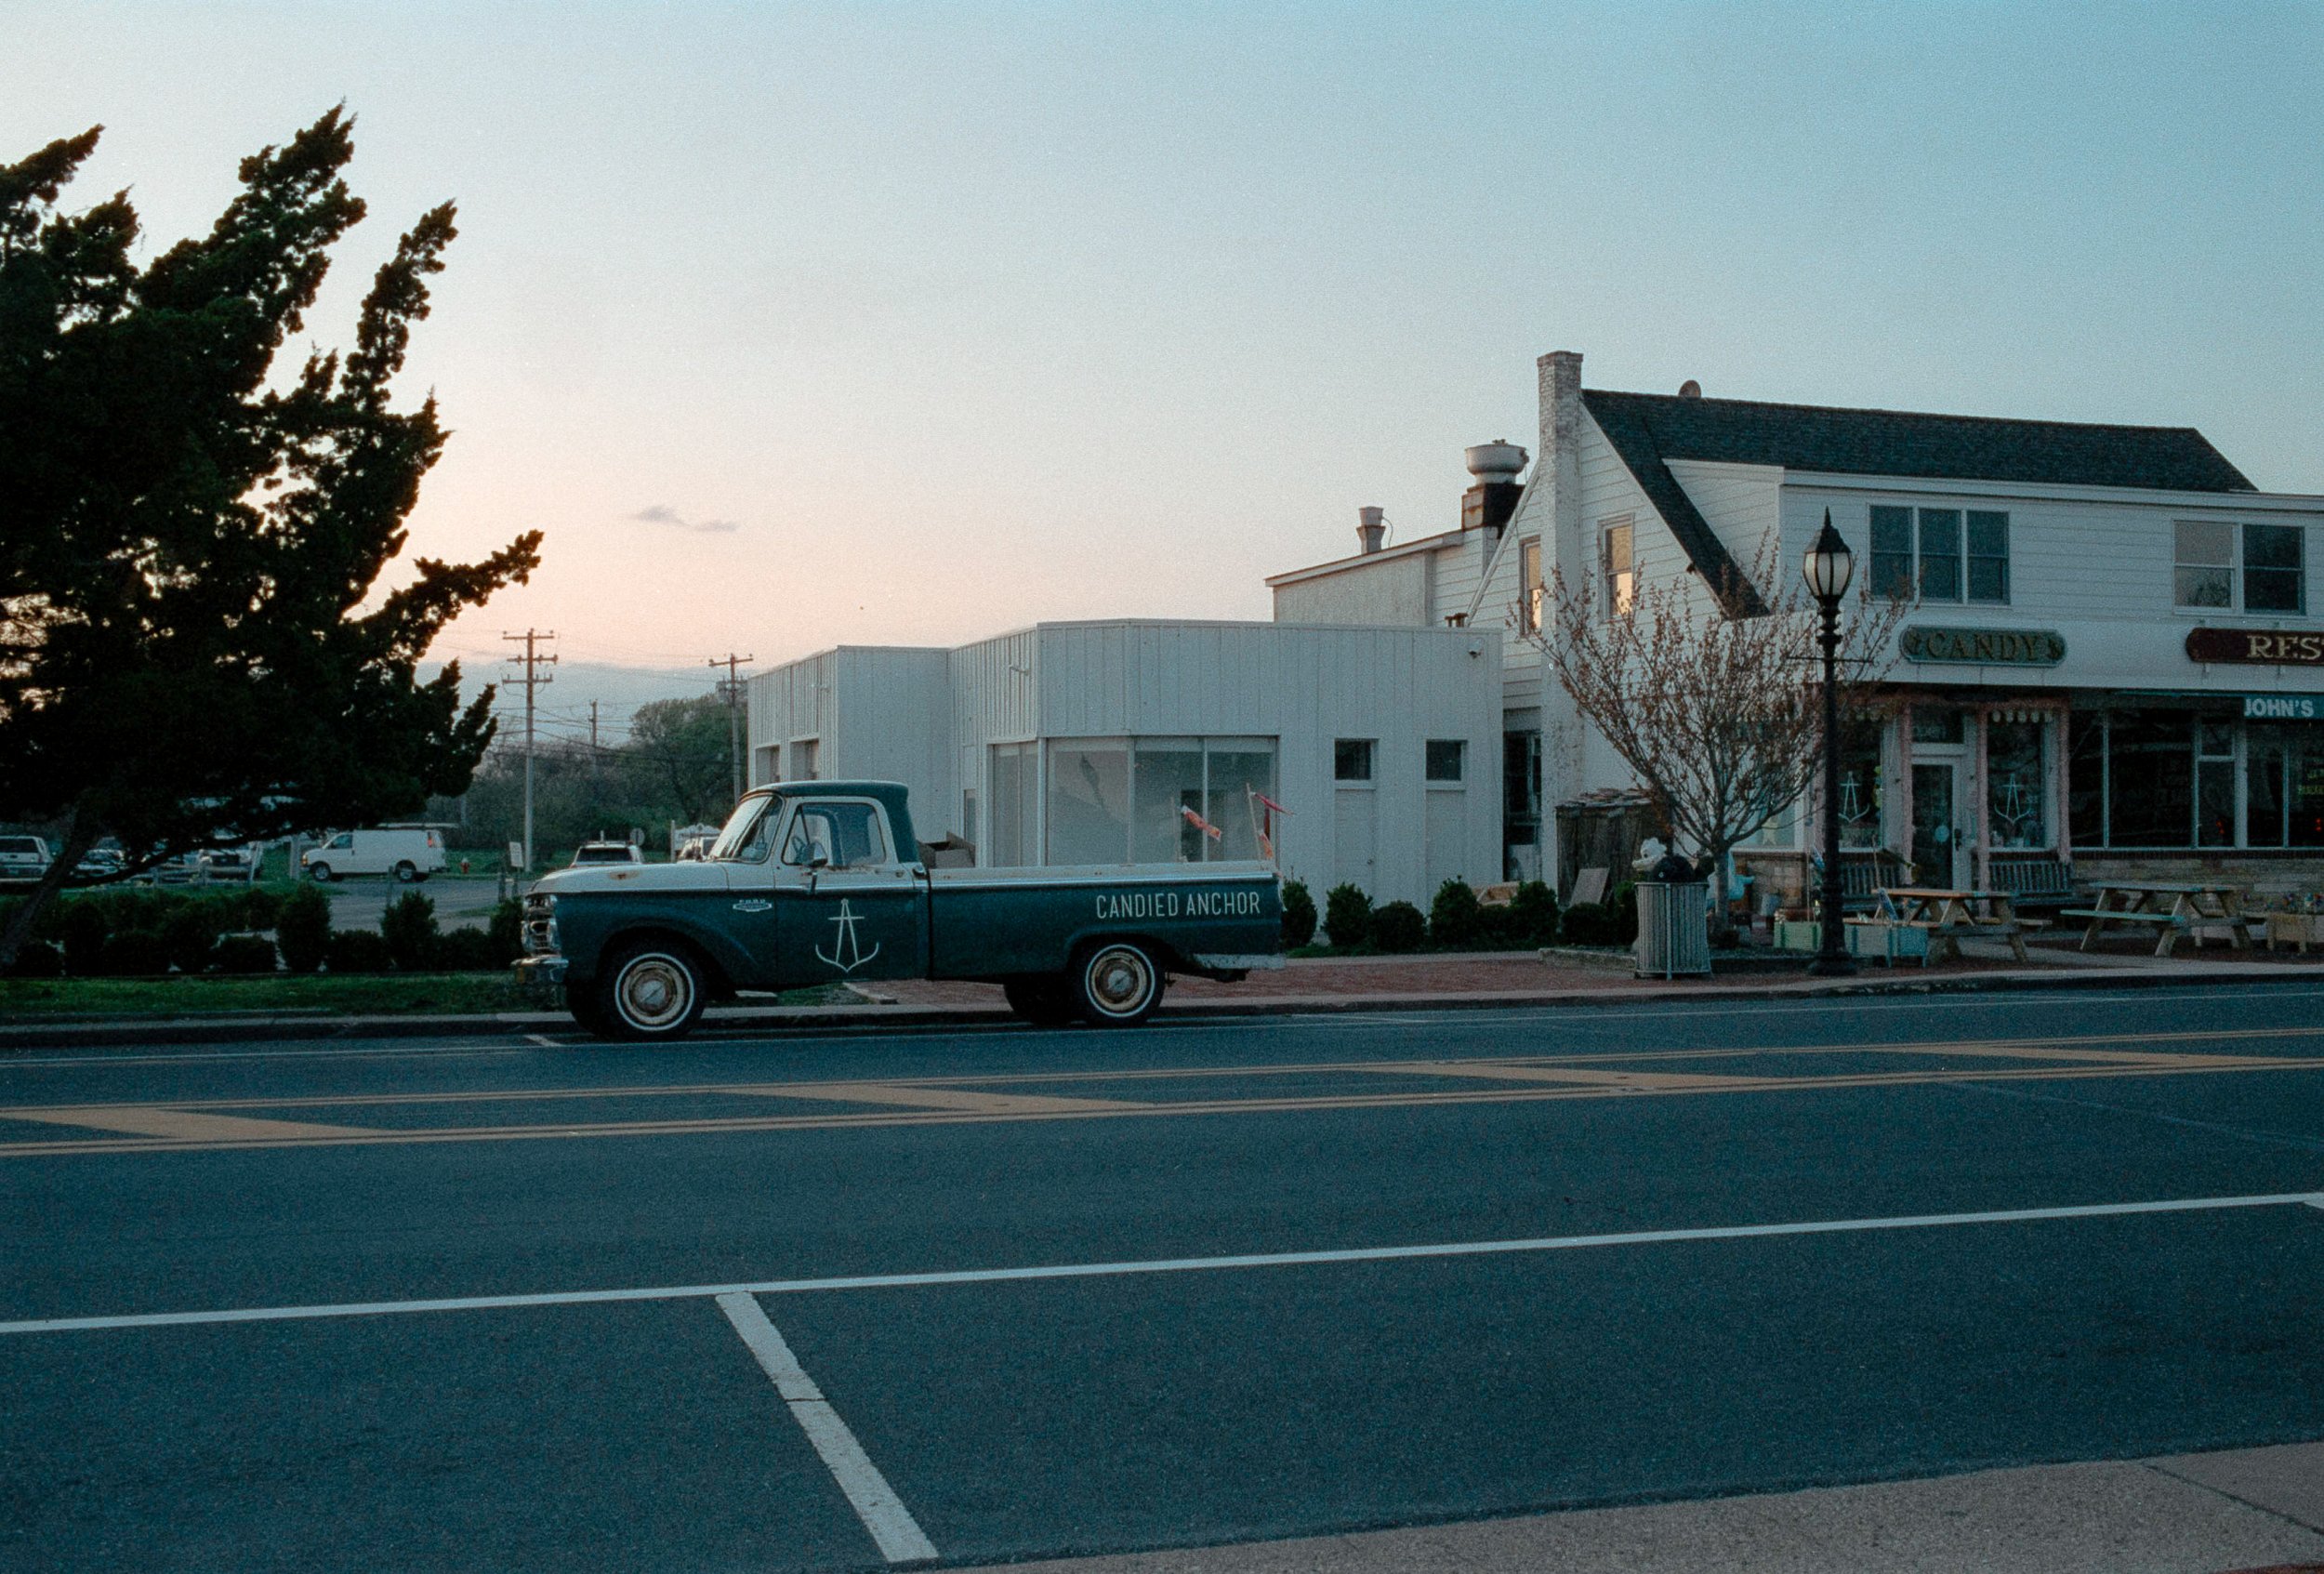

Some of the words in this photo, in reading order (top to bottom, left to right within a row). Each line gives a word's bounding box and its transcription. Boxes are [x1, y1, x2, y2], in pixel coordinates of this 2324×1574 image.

[1927, 632, 2040, 661] CANDY
[2247, 635, 2324, 660] RES
[2244, 698, 2315, 717] JOHN'S
[1096, 893, 1179, 919] CANDIED
[1186, 892, 1261, 916] ANCHOR
